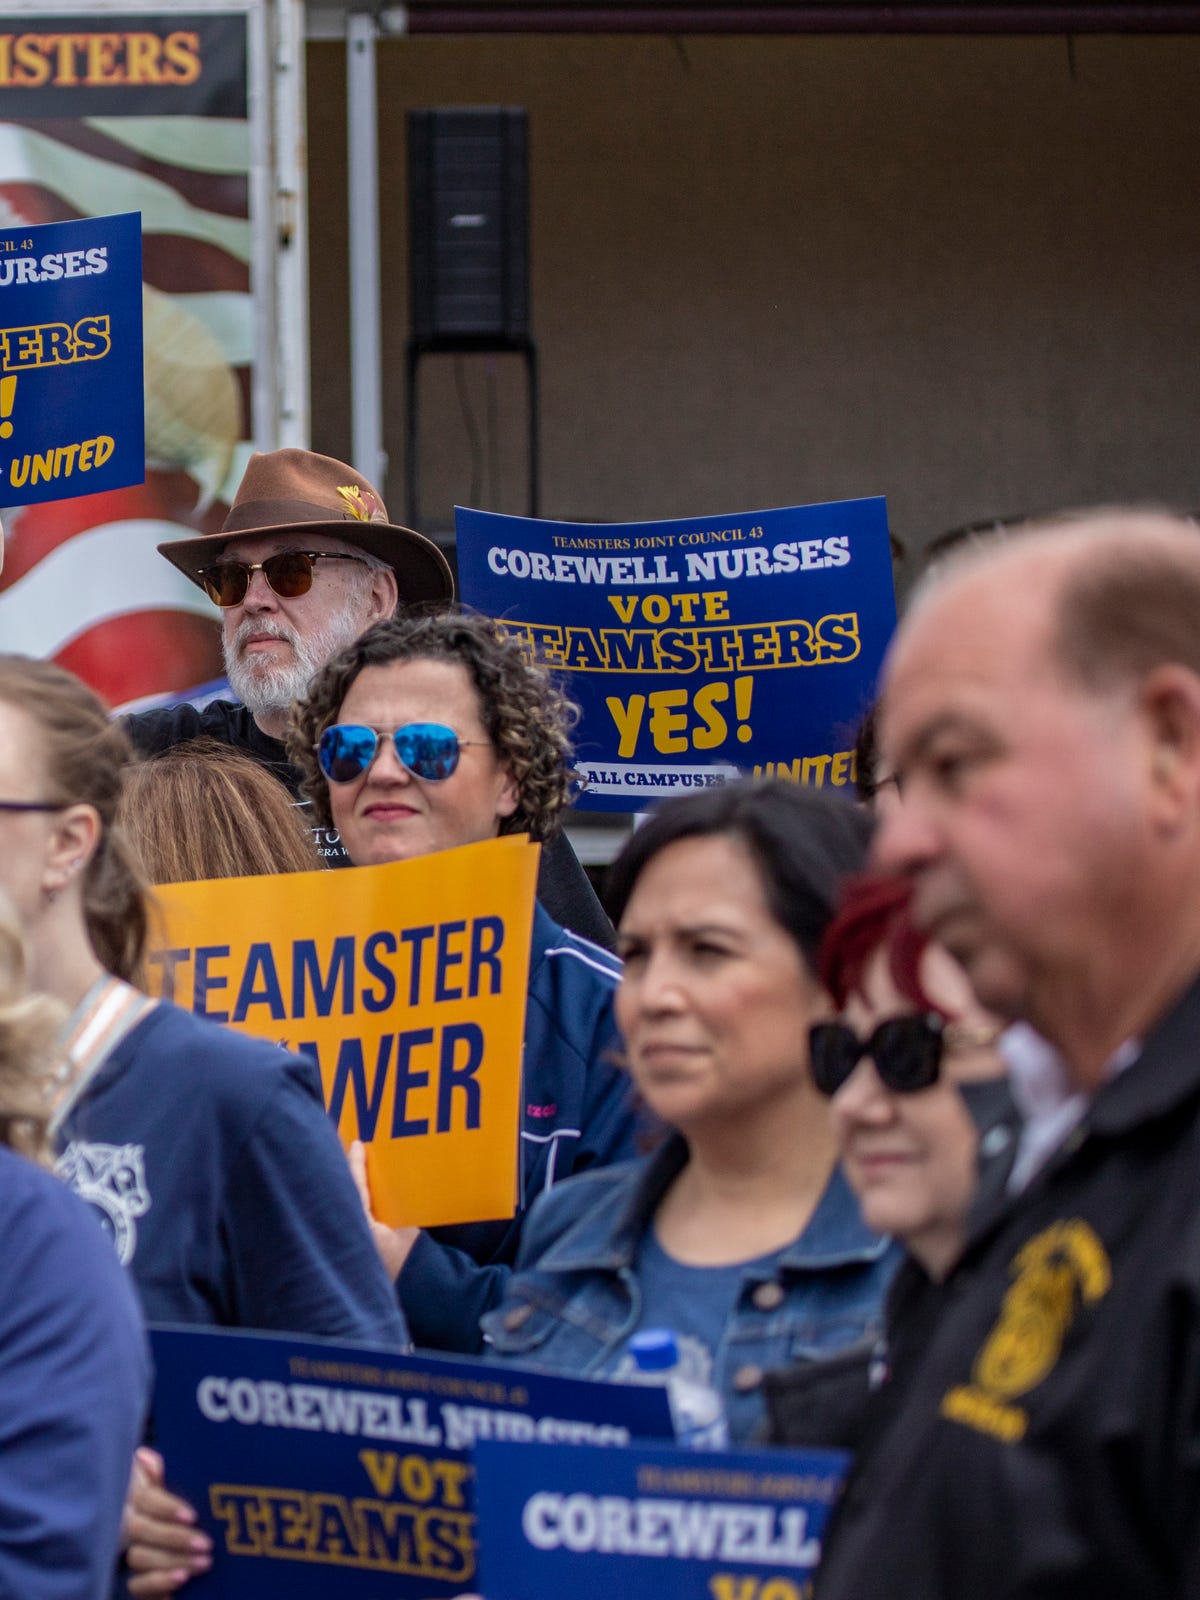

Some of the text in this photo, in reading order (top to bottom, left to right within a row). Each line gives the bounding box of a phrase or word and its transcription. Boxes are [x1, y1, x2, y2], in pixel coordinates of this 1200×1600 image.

[20, 239, 34, 250] 43
[10, 435, 116, 488] UNITED
[487, 535, 851, 584] COREWELL NURSES
[552, 526, 764, 549] TEAMSTERS JOINT COUNCIL 43
[607, 590, 730, 624] VOTE
[606, 676, 754, 758] YES!
[587, 770, 726, 788] ALL CAMPUSES
[149, 915, 505, 1024] TEAMSTER
[197, 1375, 442, 1446] COREWELL
[358, 1448, 475, 1507] VOT
[208, 1483, 477, 1584] TEAMS
[522, 1490, 822, 1568] COREWELL
